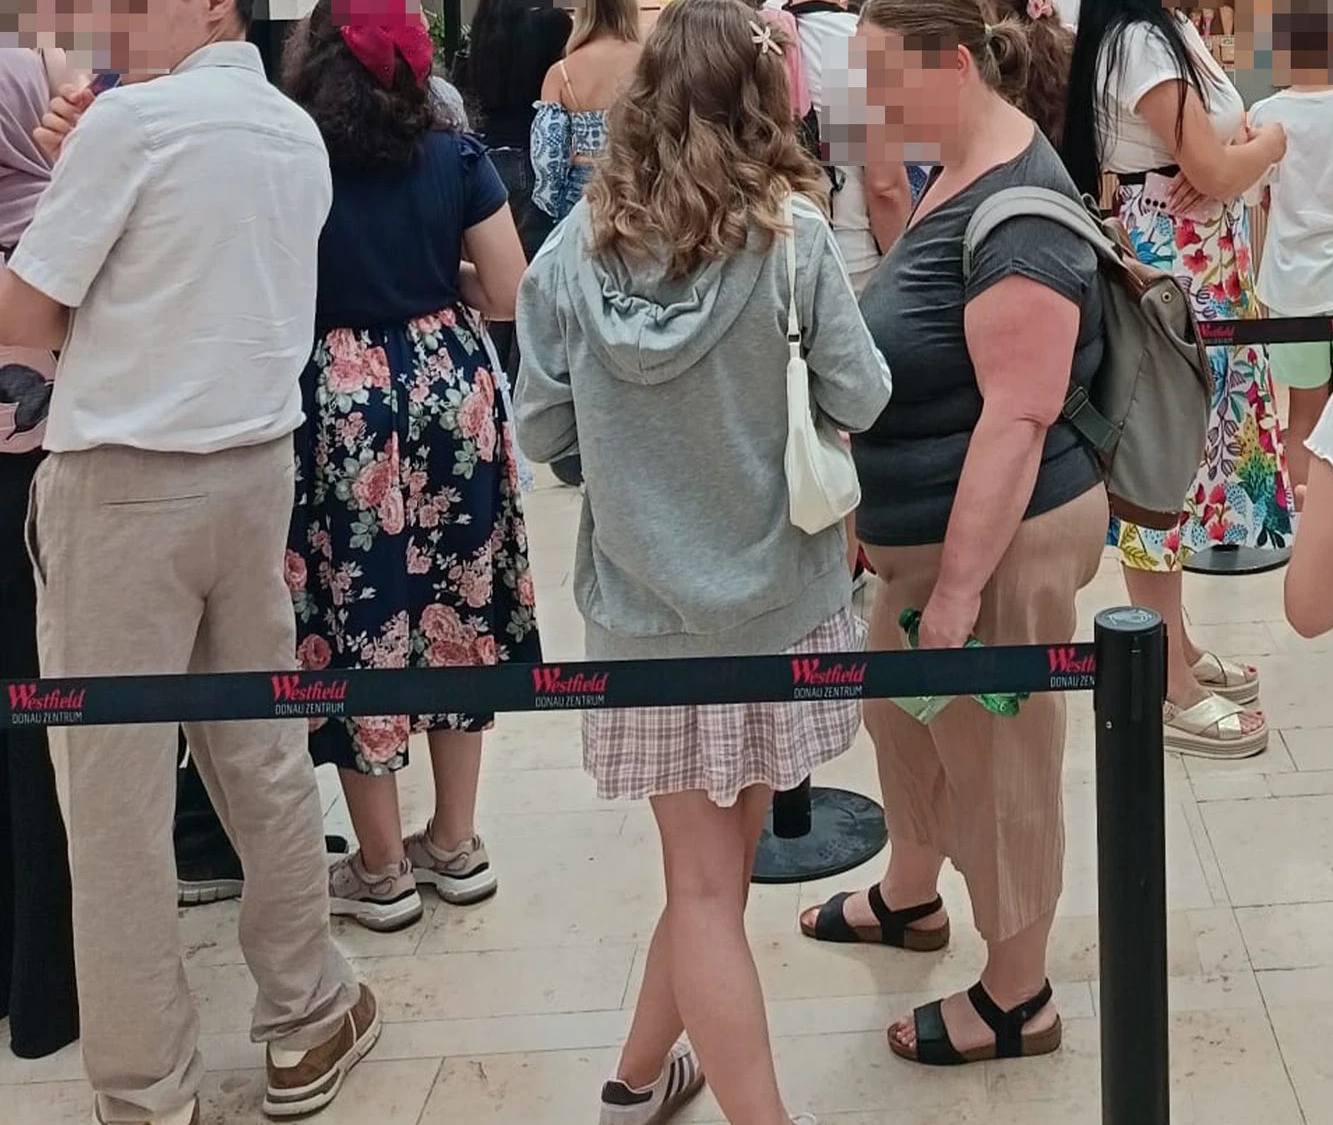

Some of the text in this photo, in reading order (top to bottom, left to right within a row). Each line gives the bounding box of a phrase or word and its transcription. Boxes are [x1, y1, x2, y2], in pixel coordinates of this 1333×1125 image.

[1047, 647, 1096, 673] Westf
[532, 666, 610, 693] Westfield
[792, 658, 868, 685] Westfield
[271, 675, 348, 702] Westfield
[794, 685, 863, 699] DONAU ZENTRUM
[1050, 676, 1078, 688] DONAU
[8, 682, 86, 711] Westfield
[535, 695, 605, 708] DONAU ZENTRUM
[12, 712, 83, 725] DONAU ZENTRUM
[275, 702, 345, 715] DONAU ZENTRUM
